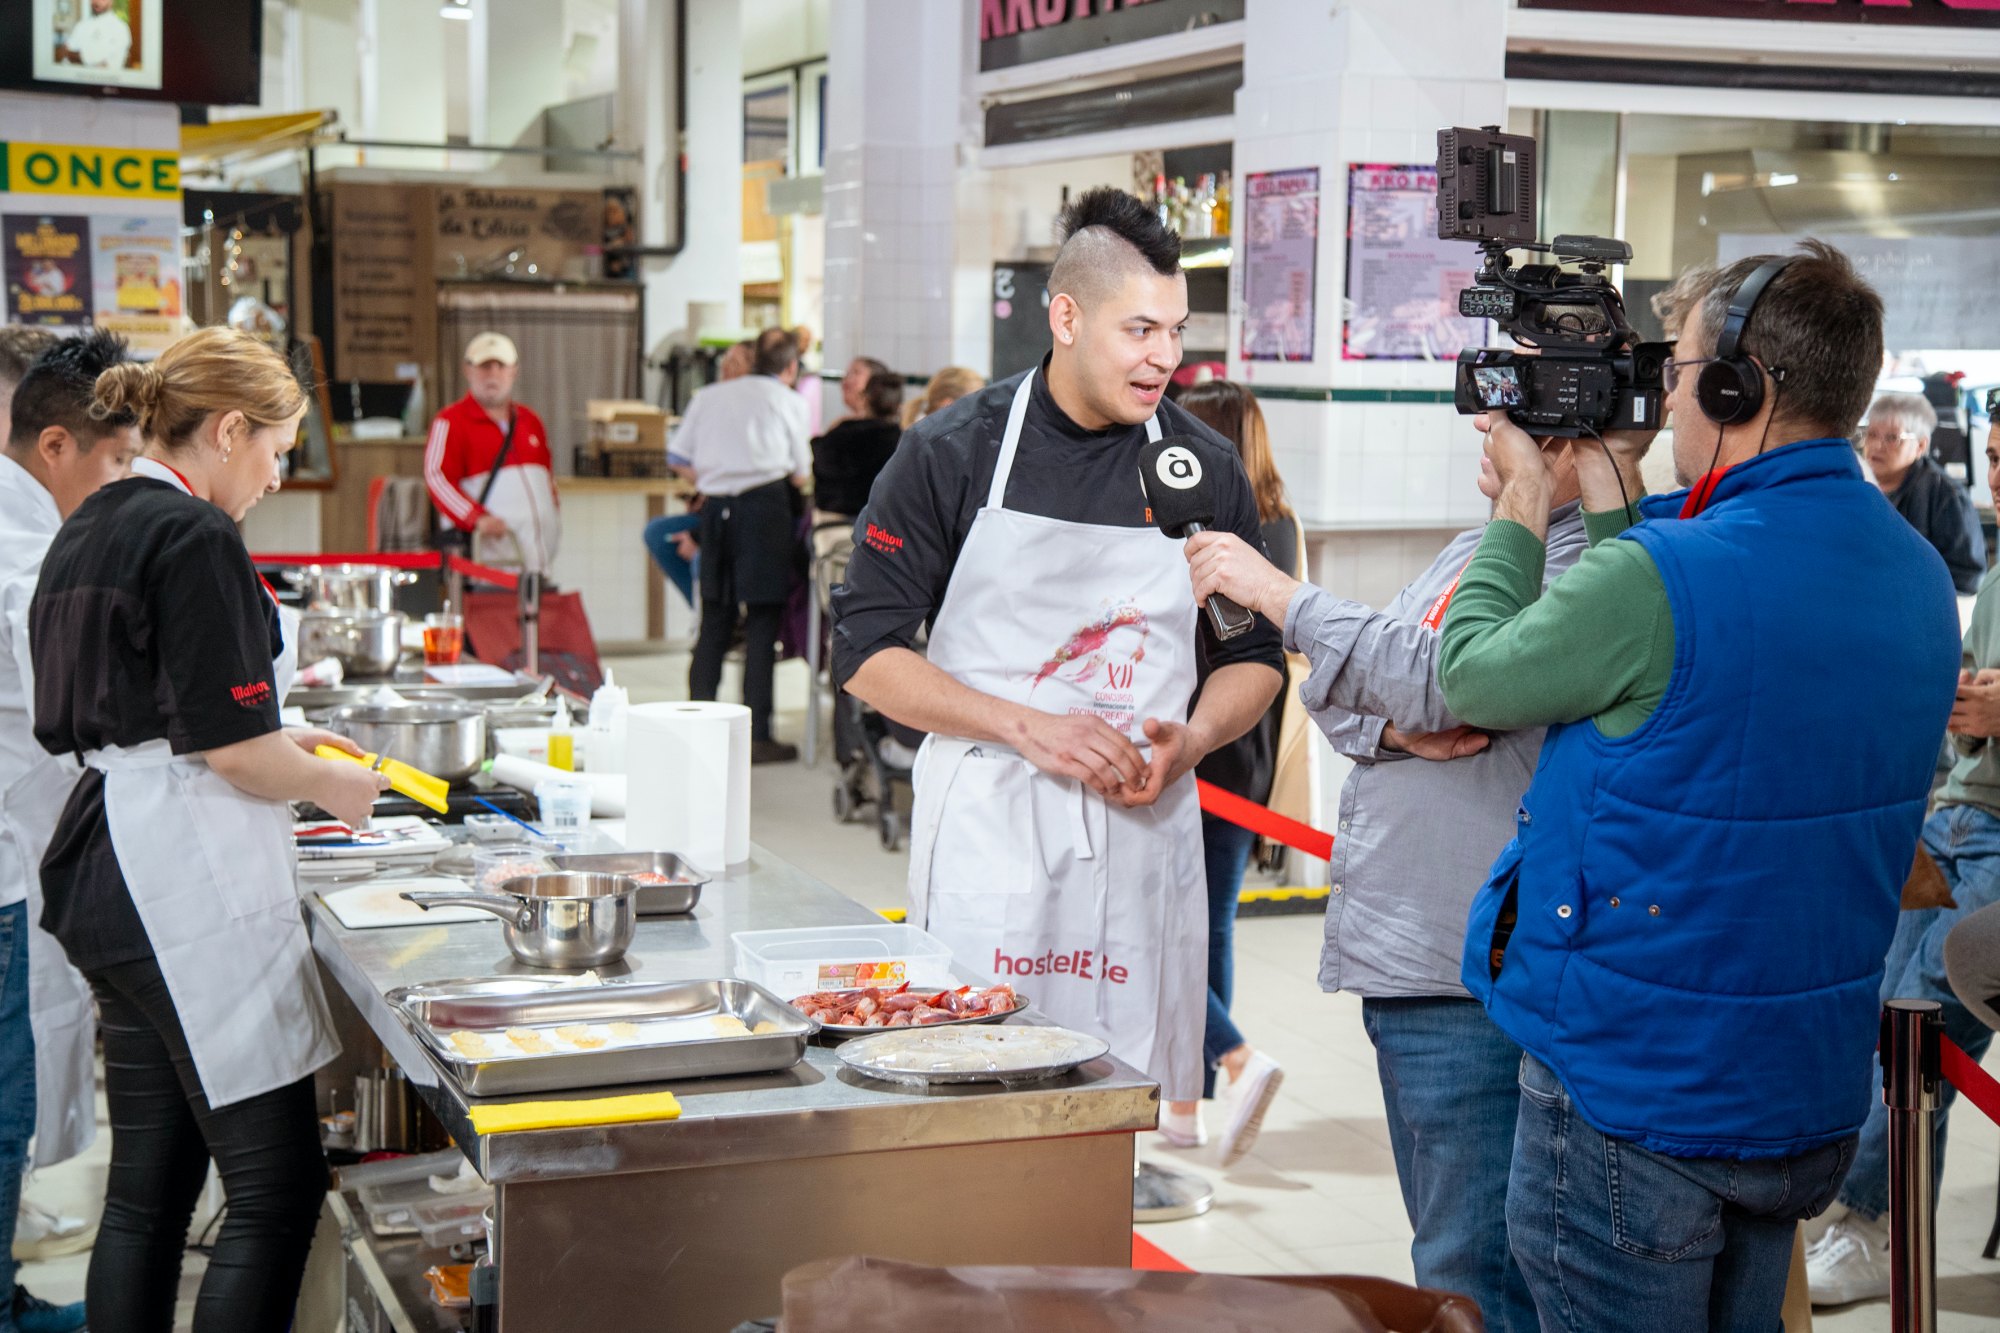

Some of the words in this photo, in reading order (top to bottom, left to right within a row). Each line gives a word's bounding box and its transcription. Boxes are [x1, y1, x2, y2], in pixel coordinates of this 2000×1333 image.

[24, 152, 178, 192] ONCE
[866, 523, 903, 548] Mahou
[1103, 663, 1133, 690] XII
[1095, 692, 1134, 703] CONCURSO
[1100, 711, 1134, 722] CREATIVA
